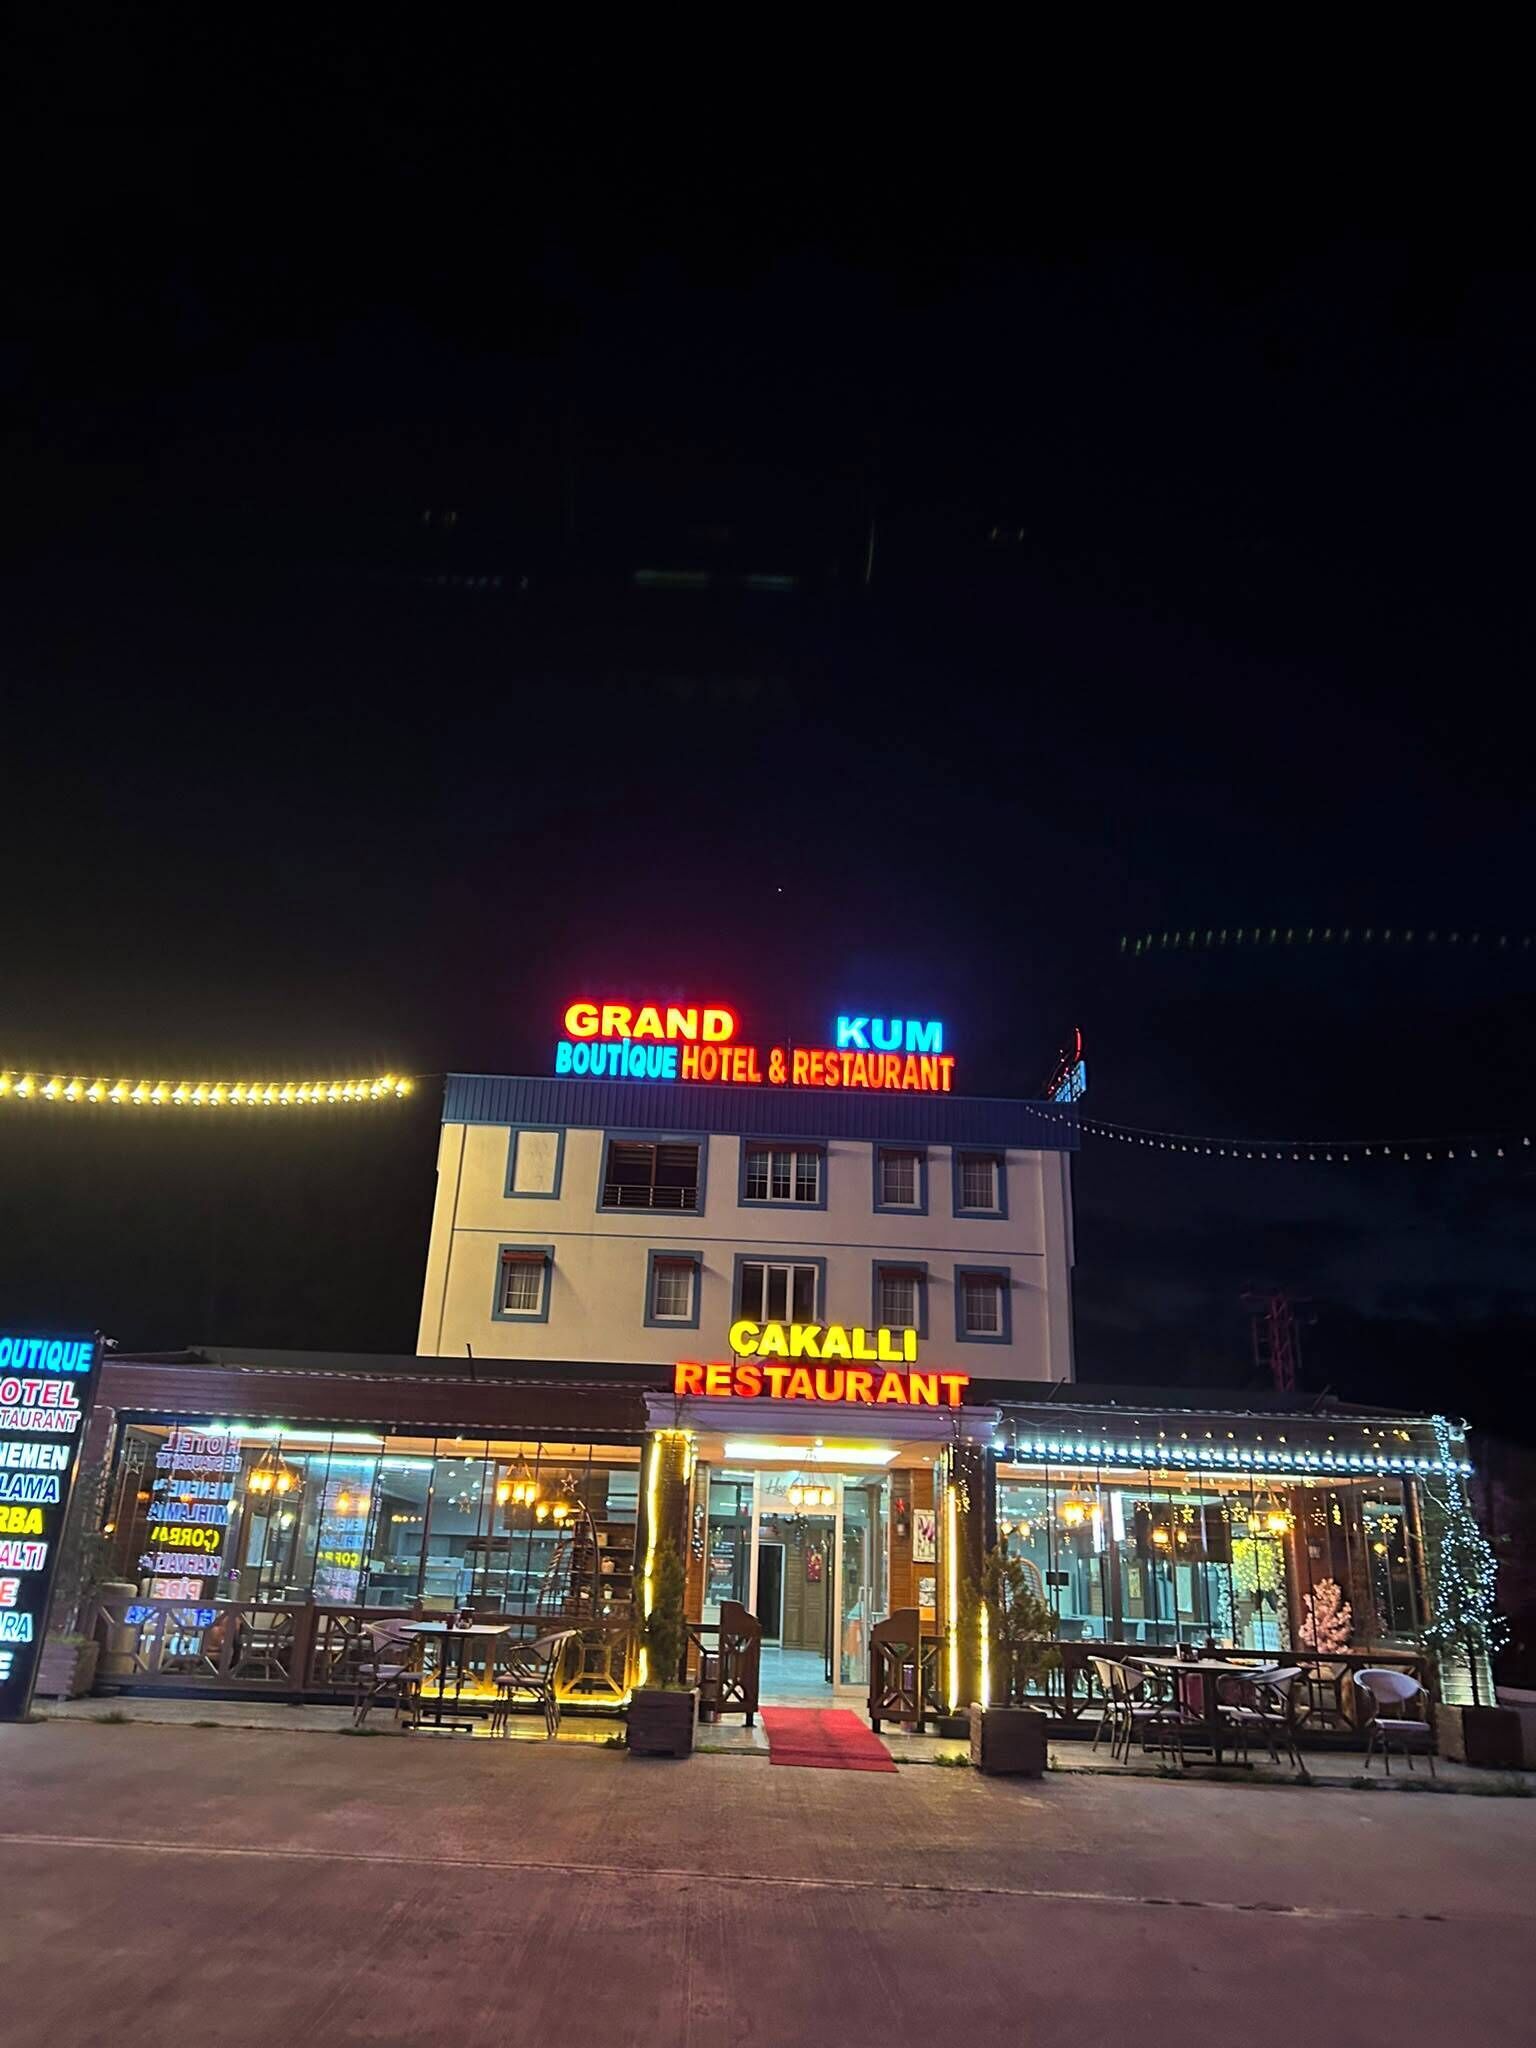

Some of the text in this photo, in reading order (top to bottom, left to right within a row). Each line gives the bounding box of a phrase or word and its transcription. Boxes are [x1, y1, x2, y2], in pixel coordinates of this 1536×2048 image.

[564, 1003, 943, 1053] GRAND KUM
[681, 1045, 762, 1083] HOTEL
[768, 1049, 788, 1084] &
[793, 1049, 955, 1092] RESTAURANT
[0, 1338, 94, 1372] OUTIQUE
[729, 1320, 918, 1362] ÇAKALLI
[0, 1378, 79, 1409] OTEL
[674, 1362, 970, 1408] RESTAURANT
[0, 1407, 81, 1433] TAURANT
[0, 1442, 70, 1471] NEMEN
[0, 1472, 60, 1504] LAMA
[0, 1506, 43, 1535] RBA
[0, 1541, 48, 1571] ALTI
